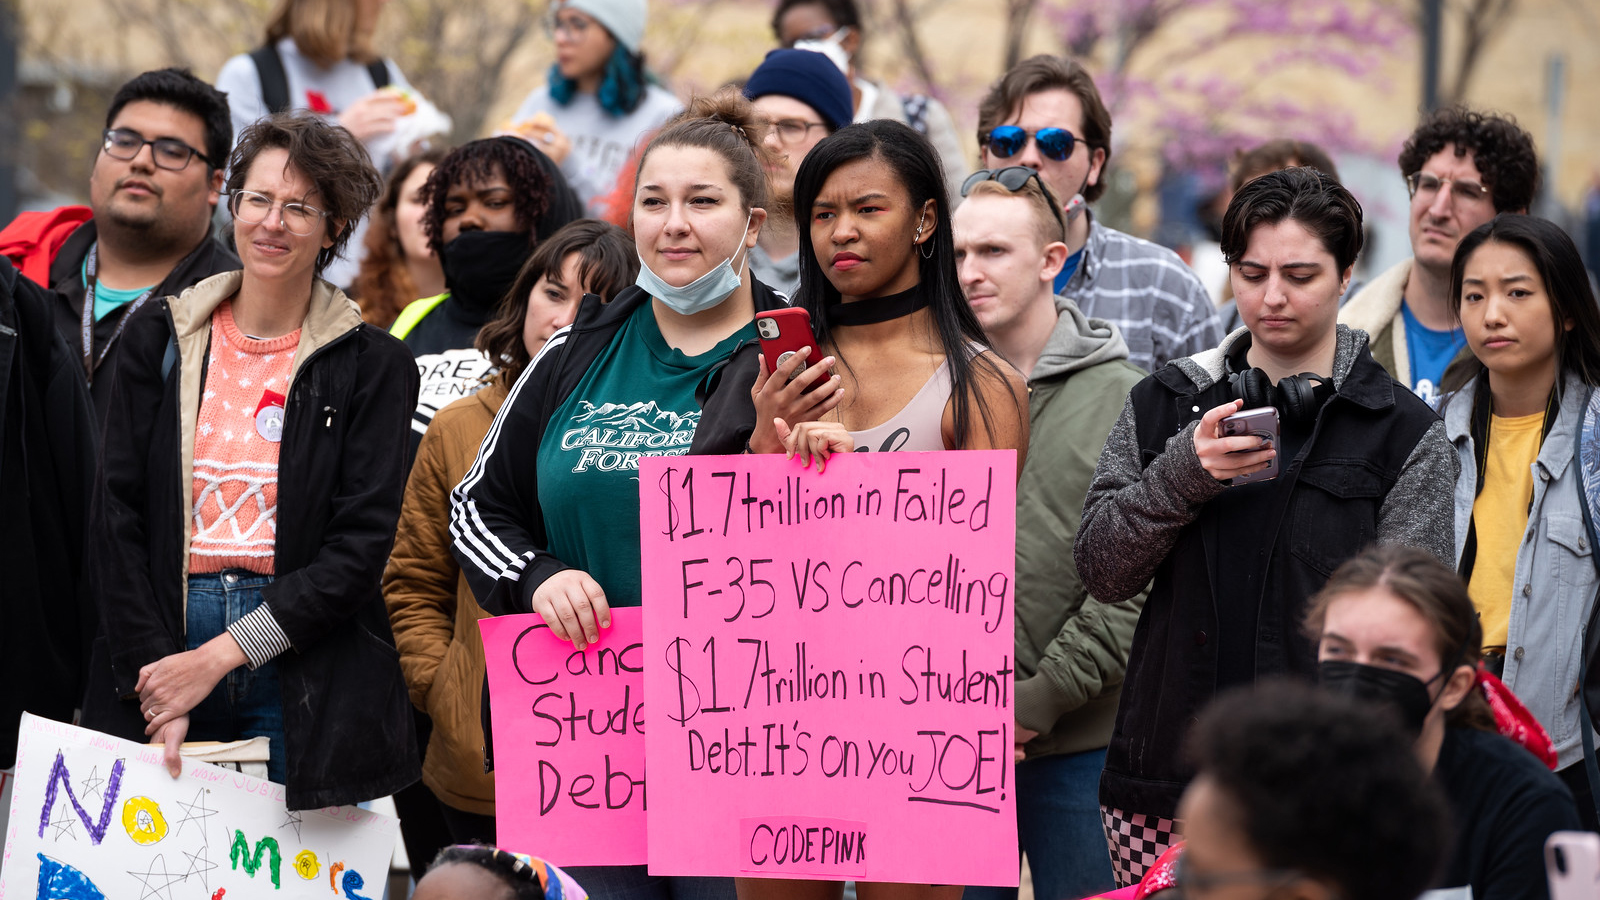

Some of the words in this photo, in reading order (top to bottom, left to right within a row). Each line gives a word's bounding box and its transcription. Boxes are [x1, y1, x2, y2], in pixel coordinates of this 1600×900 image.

[856, 484, 881, 516] in
[893, 468, 992, 532] Failed
[682, 557, 776, 623] F-35
[841, 553, 1008, 633] Cancelling
[858, 659, 885, 698] in
[900, 645, 1013, 708] Student
[89, 736, 121, 752] NOW!
[191, 768, 228, 783] NOW!
[751, 824, 867, 866] CODEPINK
